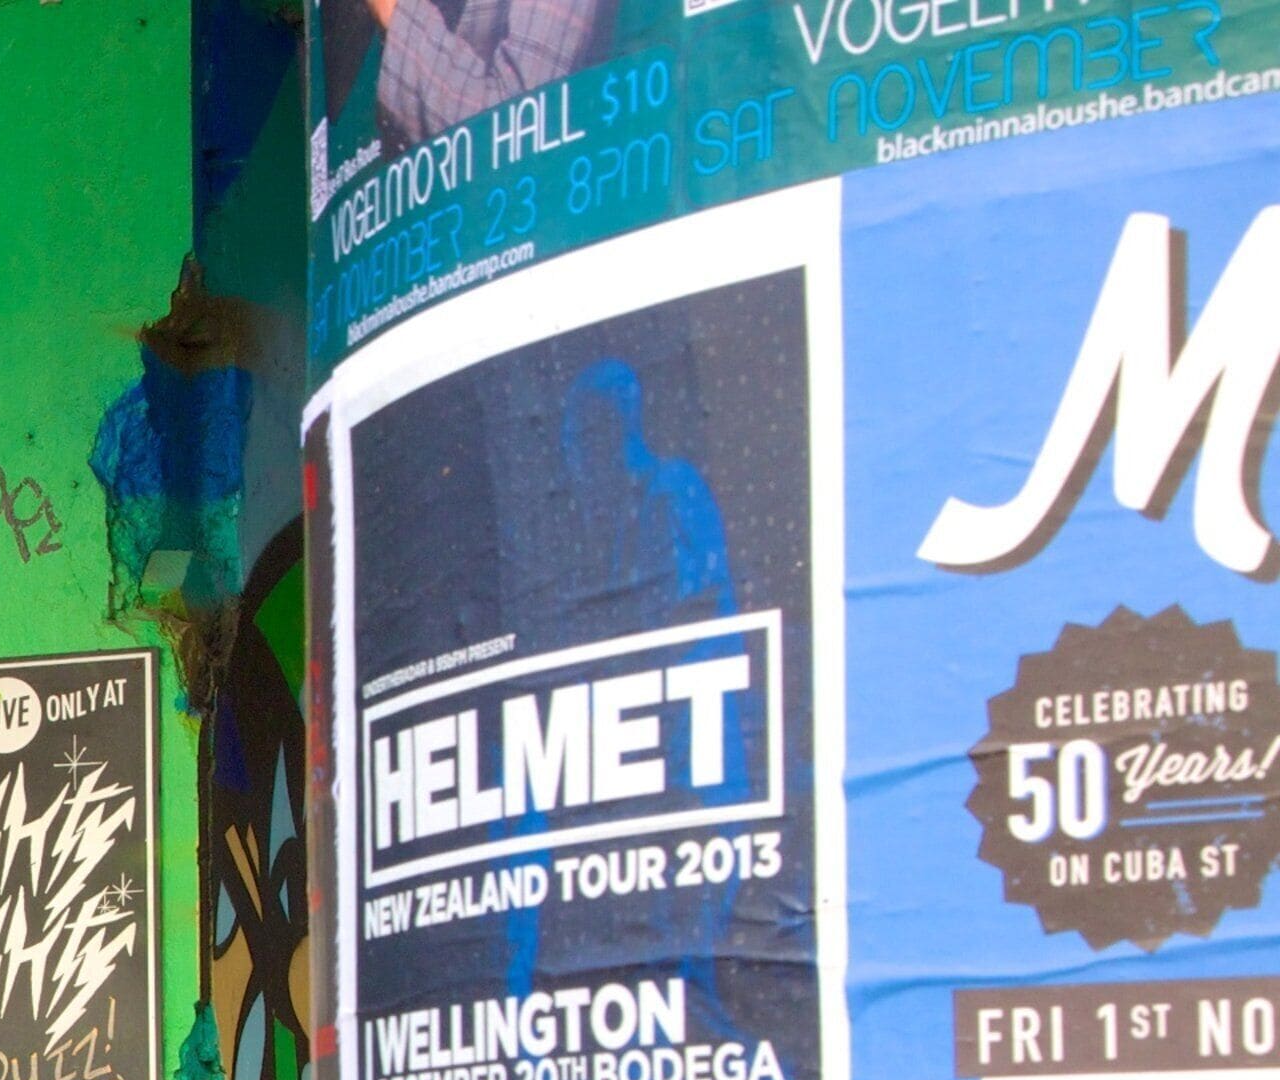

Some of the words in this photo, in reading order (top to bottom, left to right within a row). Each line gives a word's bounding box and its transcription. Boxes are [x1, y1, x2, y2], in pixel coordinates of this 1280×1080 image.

[331, 126, 472, 263] VOGELMORN
[492, 83, 586, 170] HALL
[603, 60, 669, 127] $10
[337, 203, 463, 326] NOVEMBER
[485, 176, 537, 246] 23
[568, 133, 671, 215] 8PM
[692, 87, 795, 176] SAT
[827, 0, 1223, 143] NOVEMBER
[468, 633, 516, 663] PRESENT
[46, 686, 102, 722] ONLY
[104, 679, 127, 708] AT
[1035, 679, 1249, 729] CELEBRATING
[374, 655, 750, 850] HELMET
[1007, 737, 1106, 843] 50
[1114, 739, 1278, 804] Years!
[364, 891, 413, 941] NEW
[416, 862, 548, 929] ZEALAND
[555, 847, 666, 902] TOUR
[675, 831, 782, 887] 2013
[1049, 852, 1089, 888] ON
[1103, 848, 1186, 883] CUBA
[1200, 844, 1239, 877] ST
[377, 978, 685, 1076] WELLINGTON
[976, 1005, 1065, 1065] FRI
[1096, 1003, 1172, 1061] 1ST
